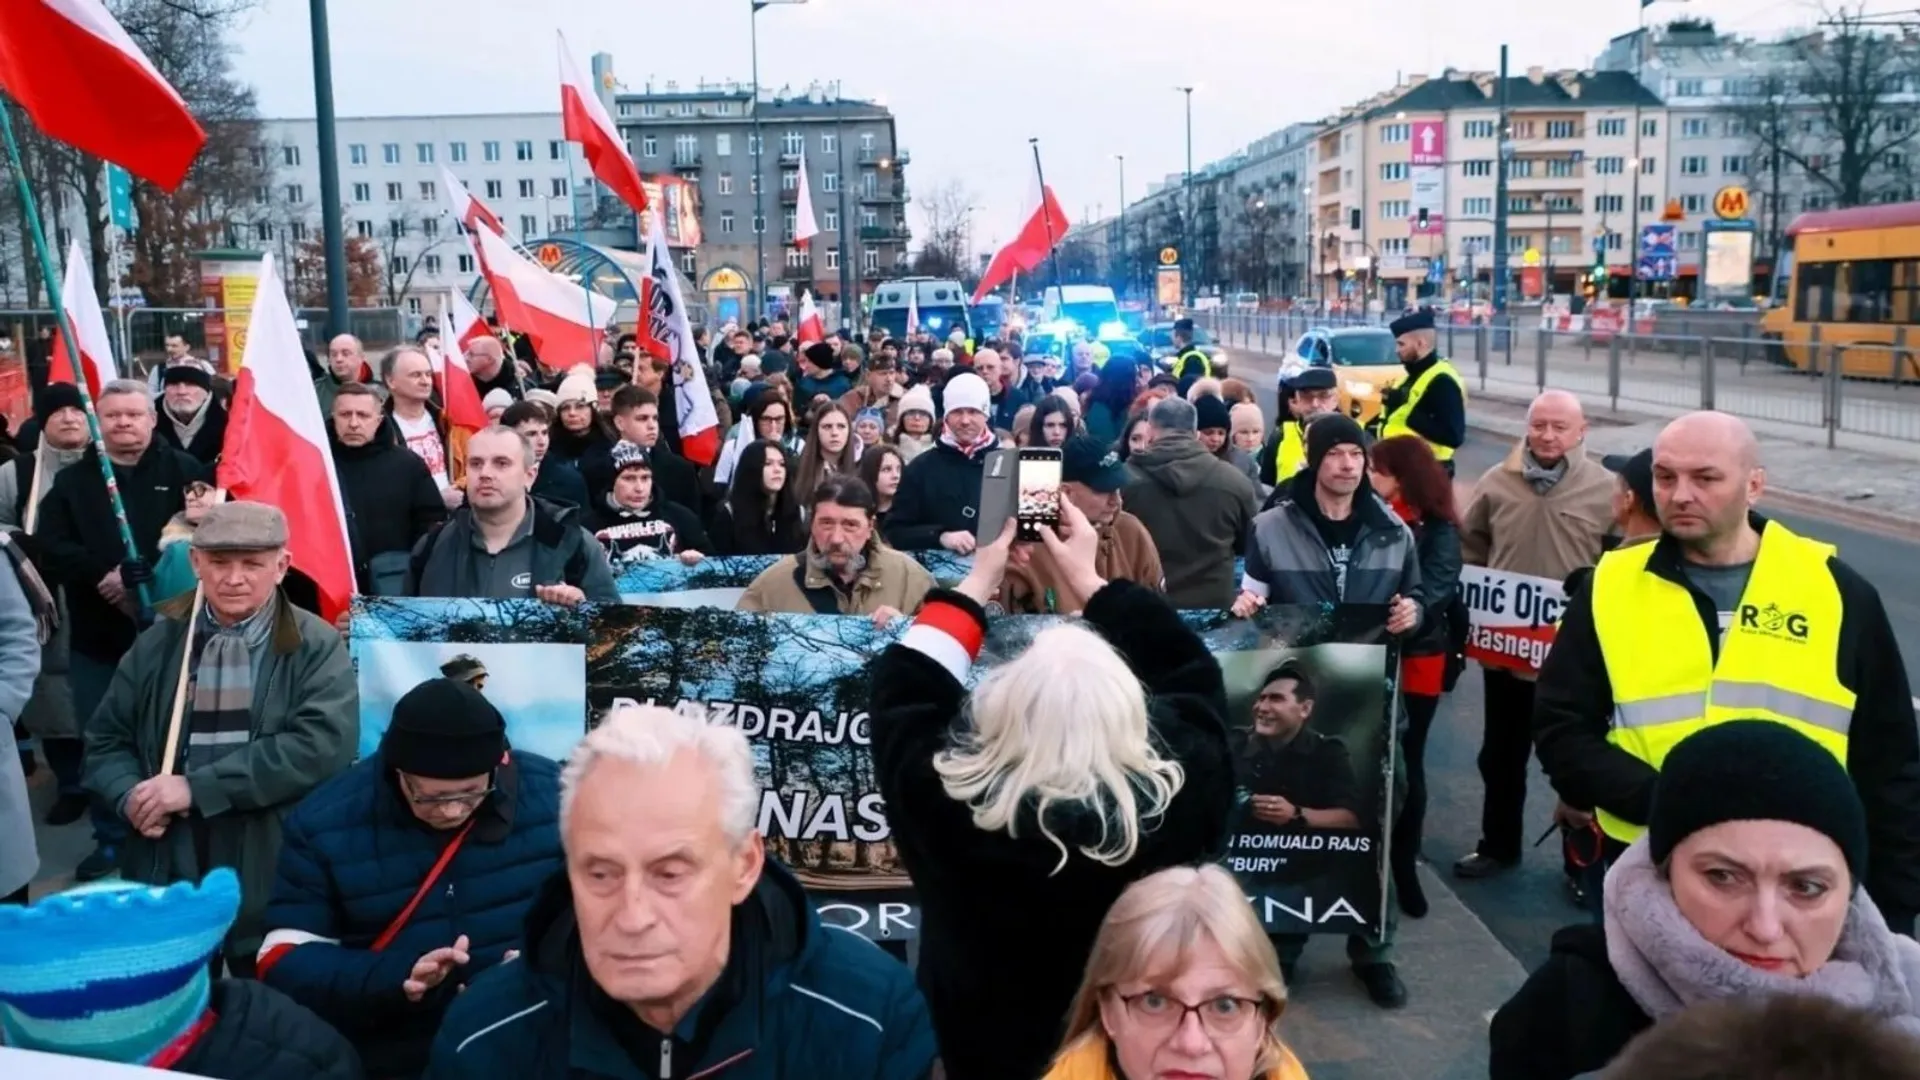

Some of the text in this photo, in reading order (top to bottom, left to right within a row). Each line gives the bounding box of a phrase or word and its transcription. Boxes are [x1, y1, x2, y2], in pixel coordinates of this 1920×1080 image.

[1514, 582, 1567, 630] Ojc
[757, 790, 891, 841] NAS
[1239, 834, 1323, 849] ROMUALD
[1328, 836, 1371, 851] RAJS
[1246, 896, 1367, 924] NA
